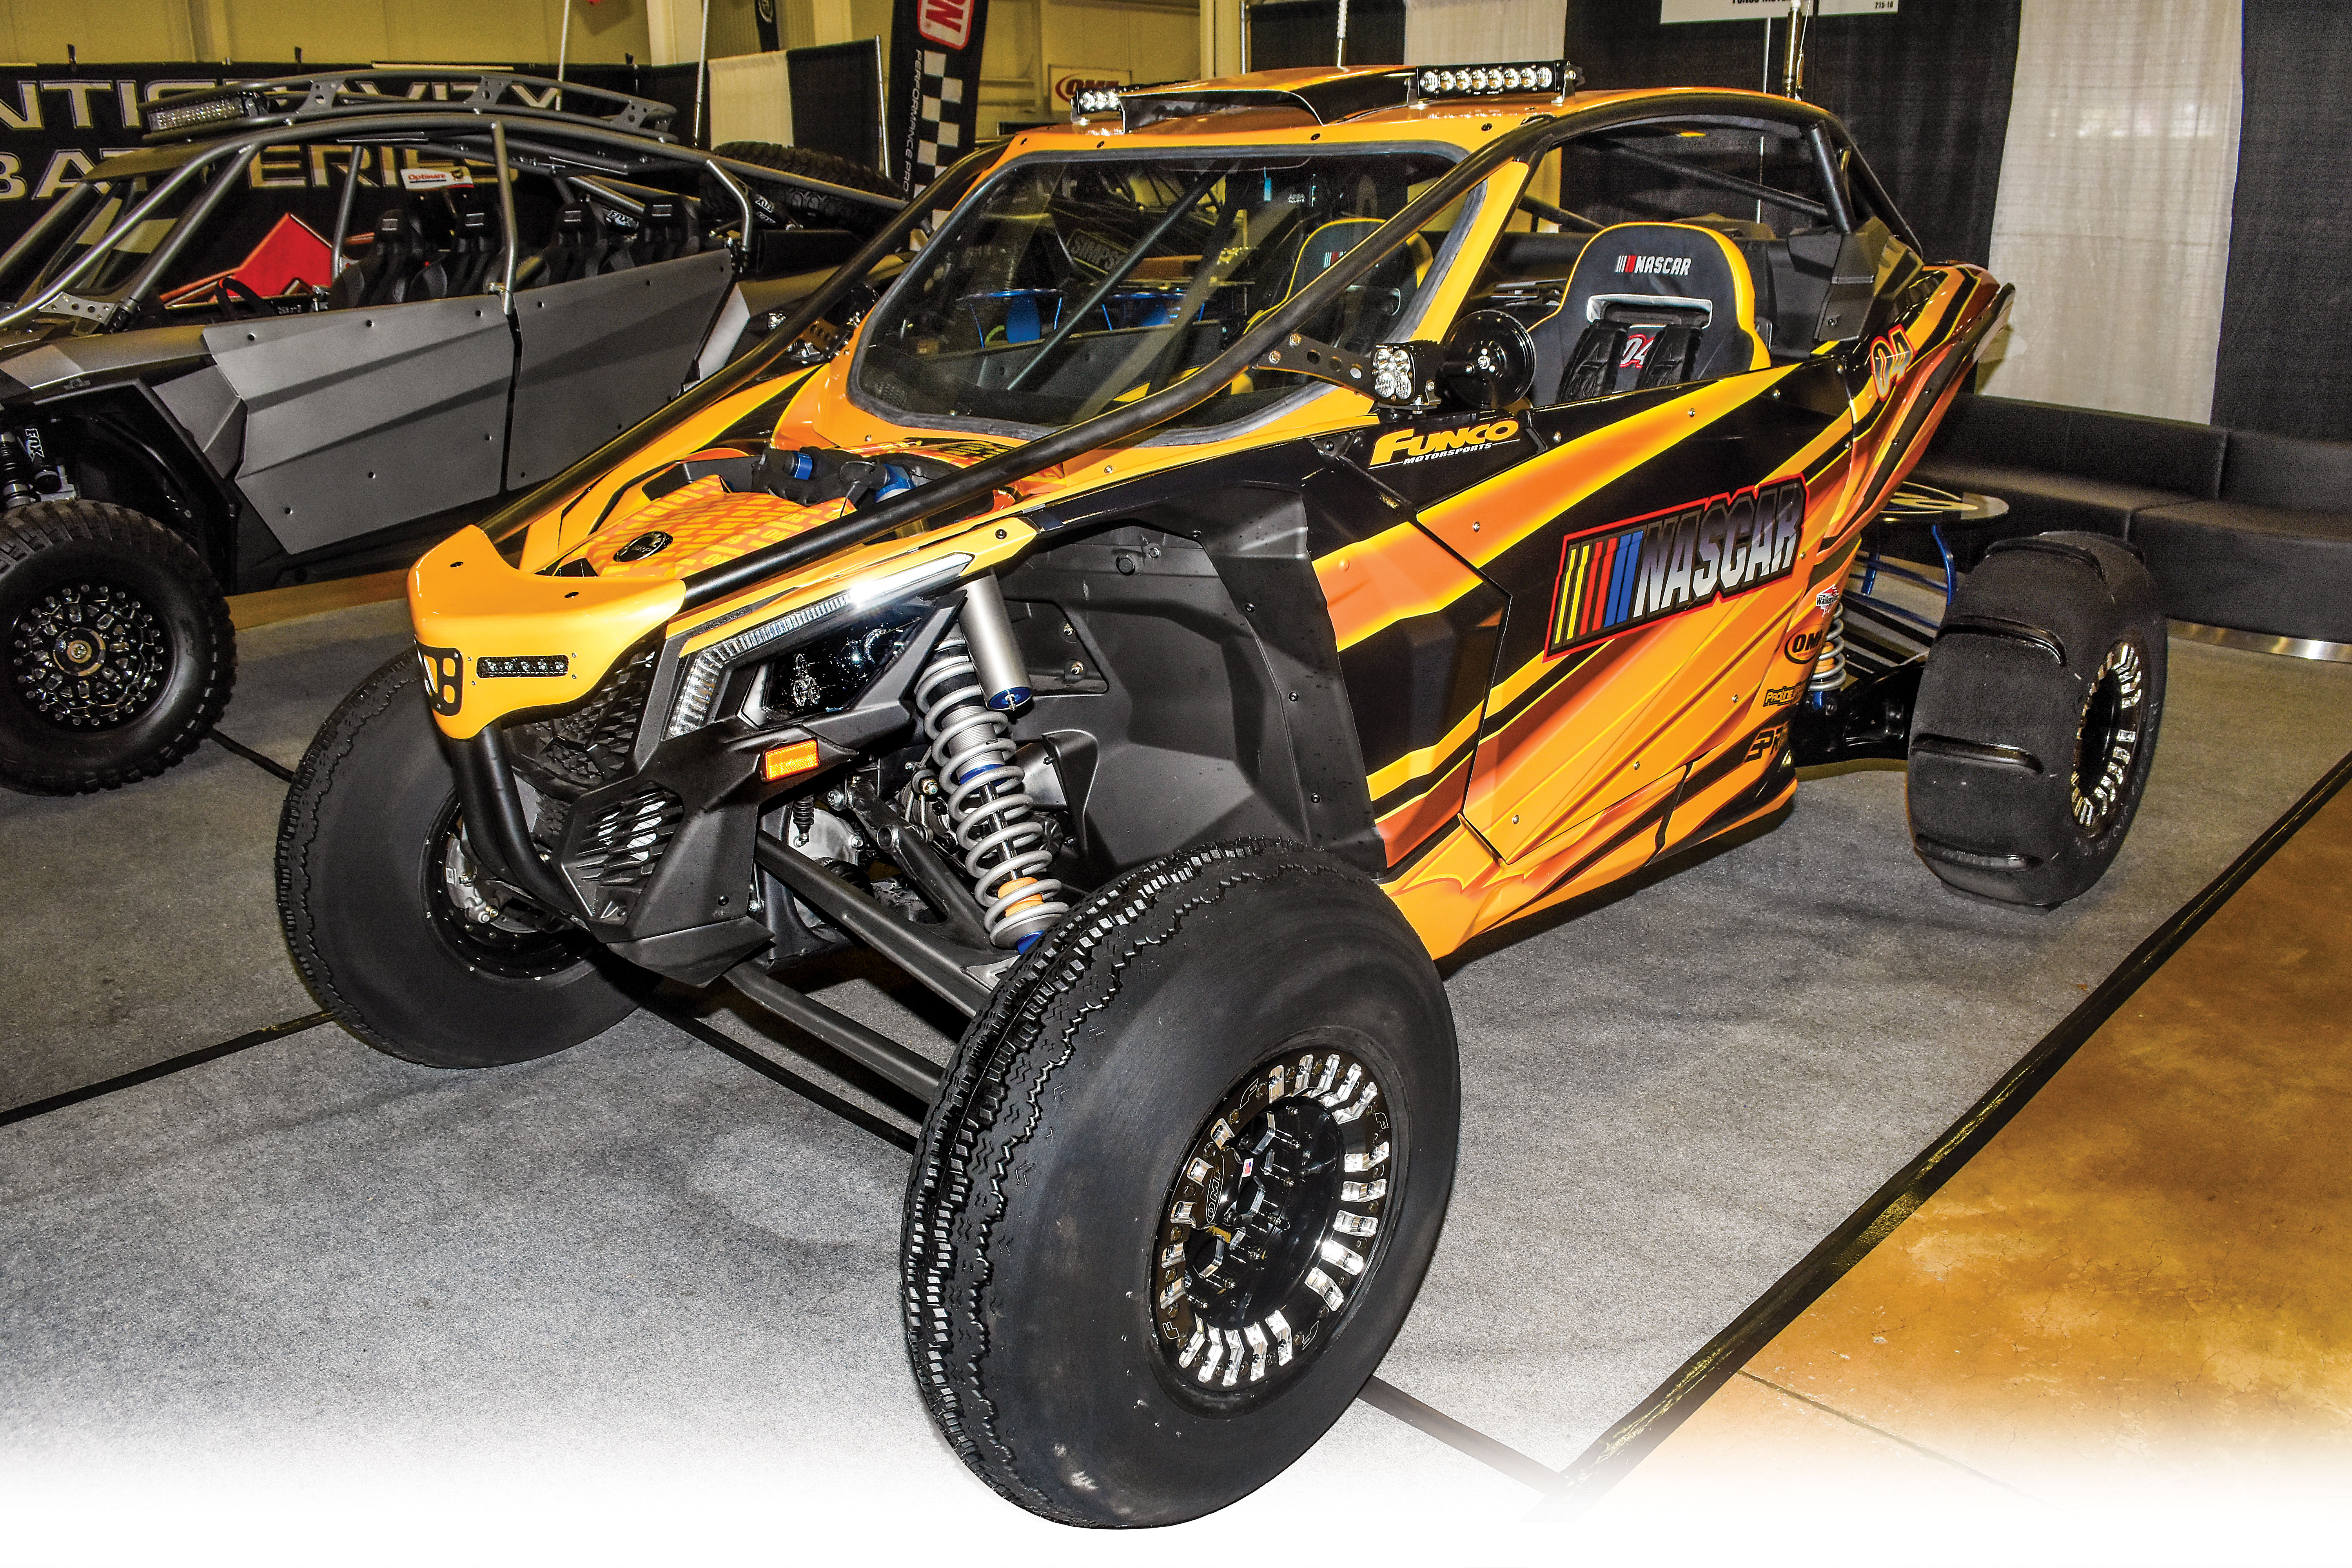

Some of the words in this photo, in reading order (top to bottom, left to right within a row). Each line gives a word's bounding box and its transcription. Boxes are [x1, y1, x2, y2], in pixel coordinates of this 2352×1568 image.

[904, 49, 922, 160] PERFORMANCE
[1634, 255, 1692, 275] NASCAR
[1869, 323, 1918, 401] 04
[1370, 419, 1519, 466] FUNCO
[1403, 443, 1493, 465] MOTORSPORTS
[1633, 482, 1804, 619] NASCAR
